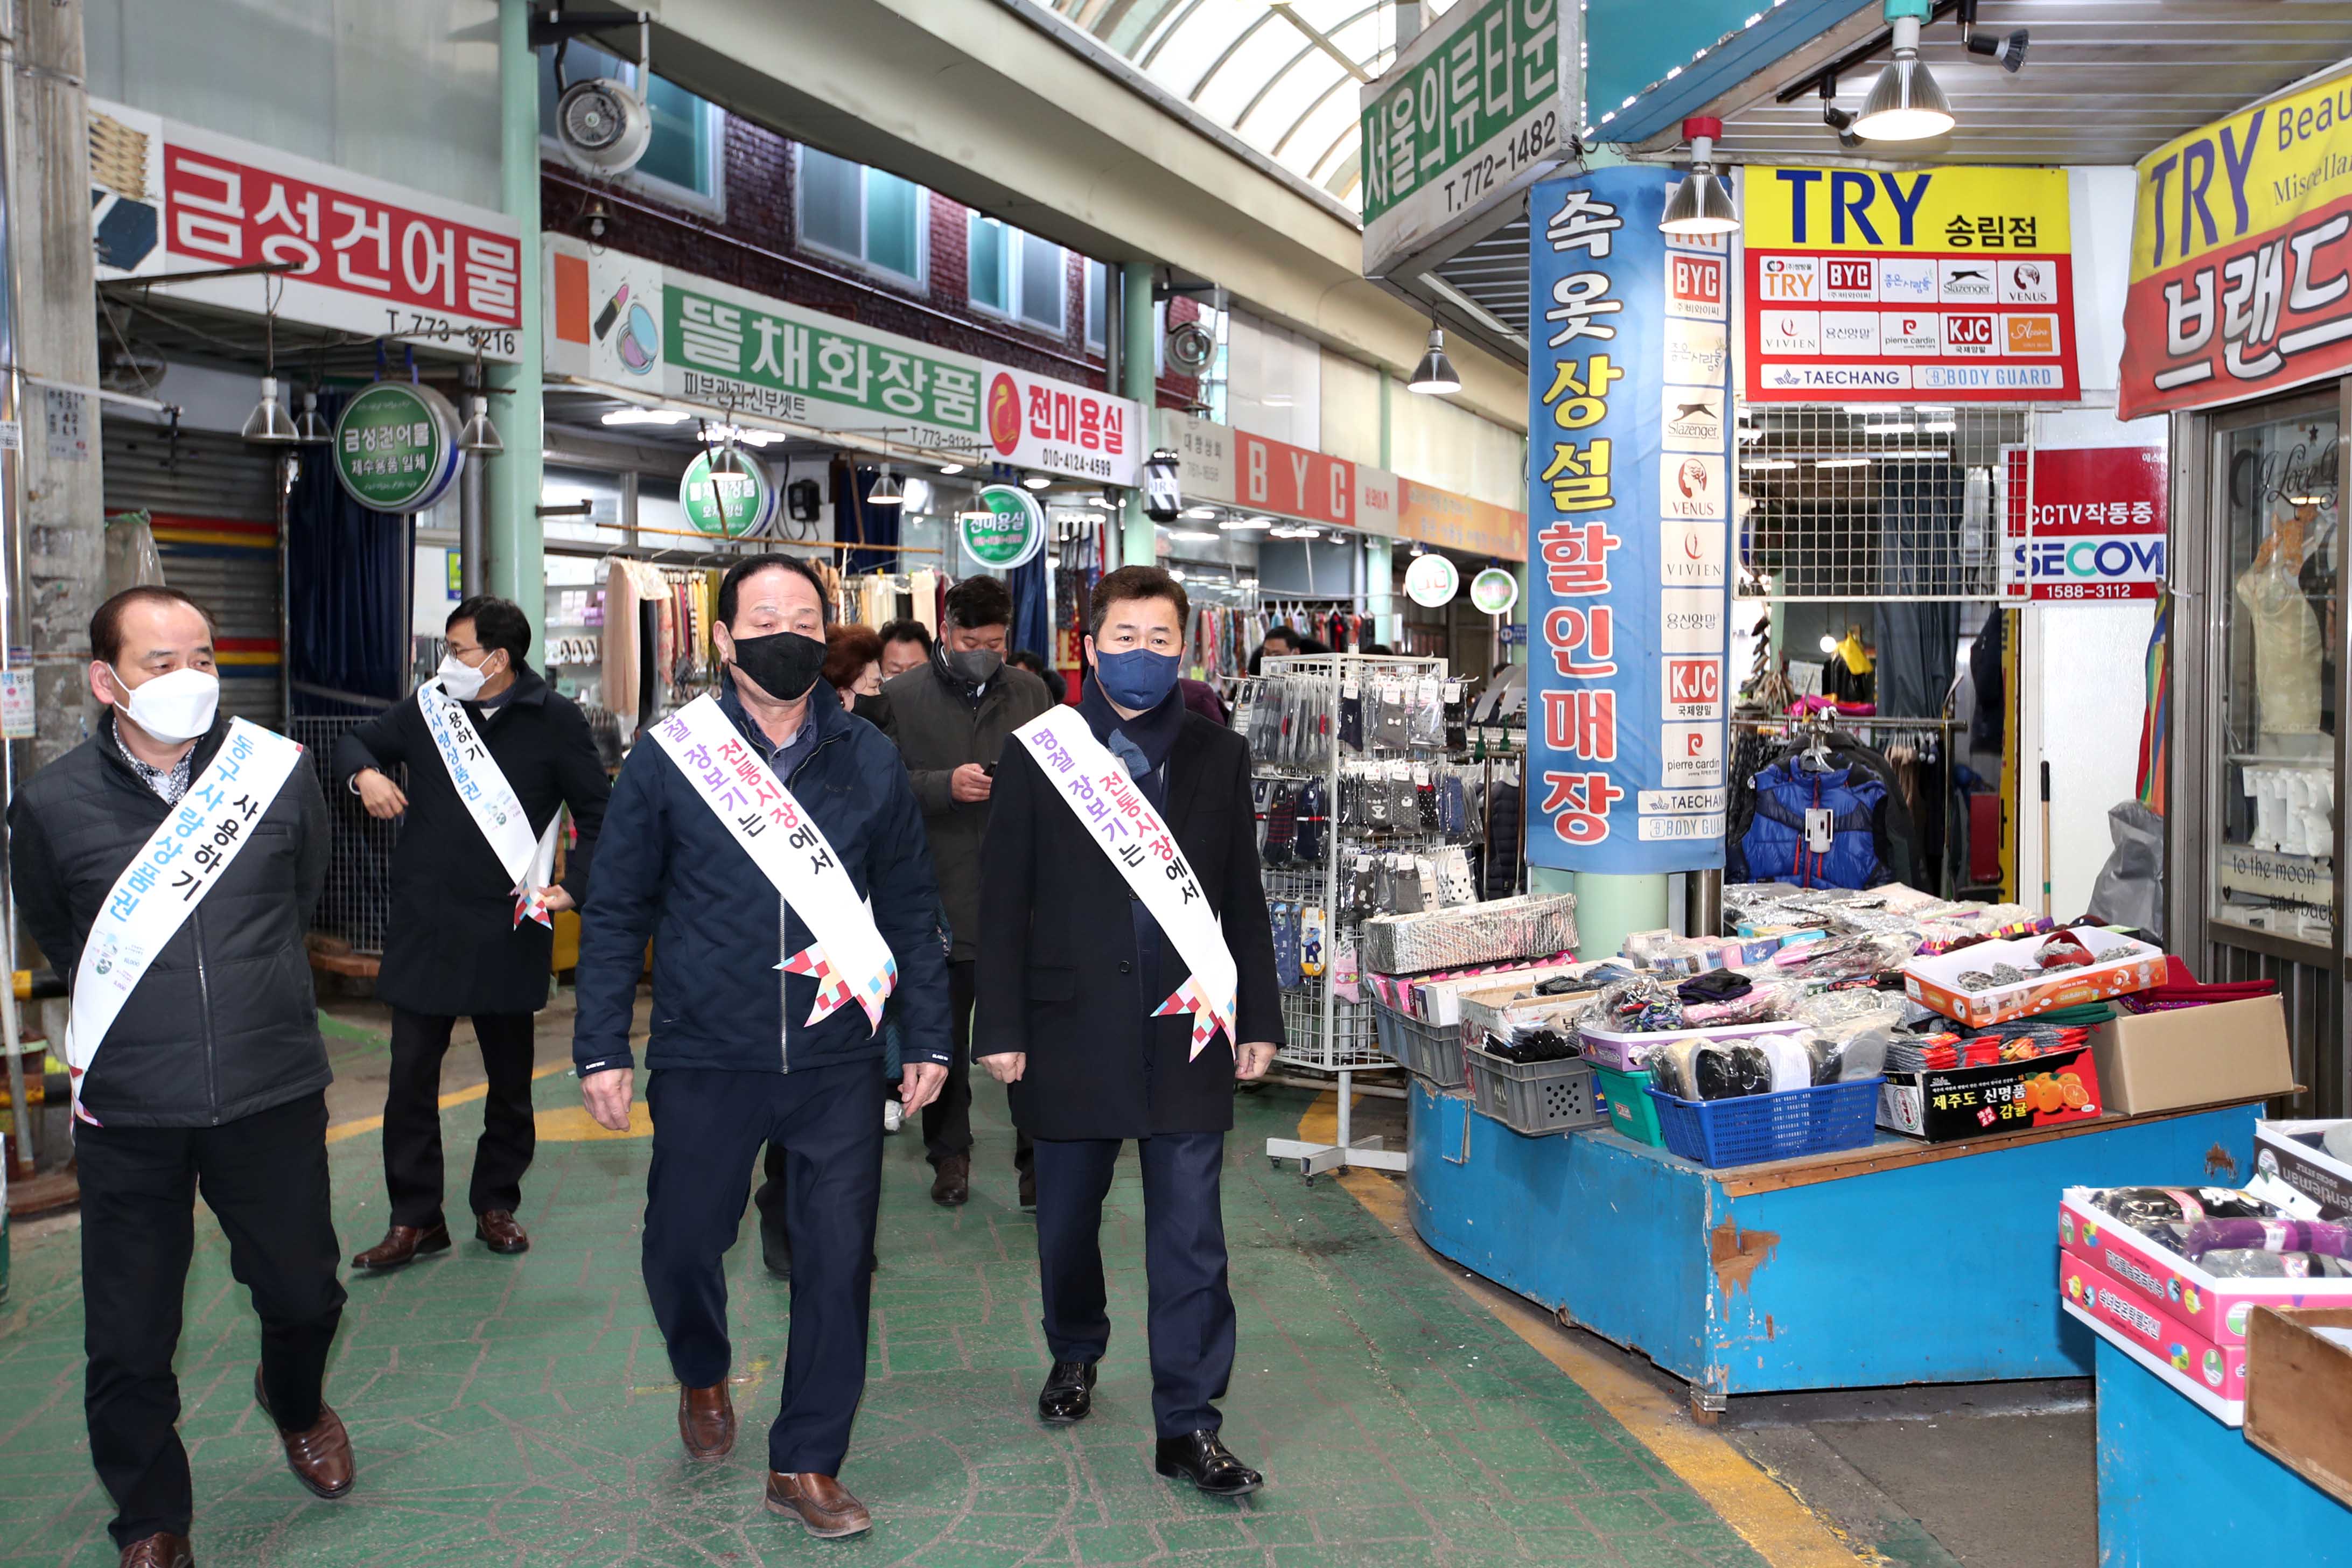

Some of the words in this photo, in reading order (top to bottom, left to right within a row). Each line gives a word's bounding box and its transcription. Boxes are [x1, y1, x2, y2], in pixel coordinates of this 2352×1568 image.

[1364, 0, 1557, 210] 서울의류타운
[1444, 111, 1556, 213] T.772-1482
[2151, 108, 2265, 268] TRY
[1776, 170, 1933, 246] TRY
[172, 158, 517, 319] 금성건어물
[1944, 215, 2037, 248] 송림점
[1676, 261, 1717, 299] BYC
[1765, 274, 1814, 297] TRY
[1831, 264, 1868, 286] BYC
[1943, 283, 1991, 295] Slazenger
[2009, 292, 2047, 302] VENUS
[1885, 337, 1908, 345] pierre
[1949, 317, 1991, 342] KJC
[1766, 339, 1815, 349] VIVIEN
[680, 296, 977, 426] 뜰채화장품
[1804, 370, 1899, 384] TAECHANG
[1948, 369, 1990, 384] BODY
[1997, 369, 2052, 384] GUARD
[1028, 384, 1123, 455] 전미용실
[1668, 422, 1719, 439] Slazenger
[345, 423, 429, 453] 금성건어물
[402, 453, 426, 473] 일체
[1042, 447, 1111, 477] 010-4124-4599
[1248, 440, 1346, 518] BYC
[1672, 502, 1714, 516] VENUS
[1667, 564, 1721, 577] VIVIEN
[2015, 541, 2164, 577] SECOM
[2047, 585, 2131, 598] 1588-3112
[1672, 665, 1717, 698] KJC
[1678, 705, 1712, 716] 국제양말
[1032, 728, 1075, 774] 명절
[1668, 759, 1693, 772] pierre
[1696, 758, 1719, 769] cardin
[717, 737, 835, 876] 전통시장에서
[1671, 794, 1724, 809] TAECHAN
[1099, 771, 1200, 905] 전통시장에서
[1667, 819, 1697, 836] BODY
[172, 793, 258, 901] 사용하기
[2234, 855, 2245, 874] to
[2251, 855, 2271, 880] the
[2276, 863, 2315, 885] moon
[2270, 892, 2295, 914] and
[1933, 1091, 1978, 1110] 제주도
[1984, 1084, 2026, 1104] 신명품
[1999, 1102, 2027, 1119] 감귤
